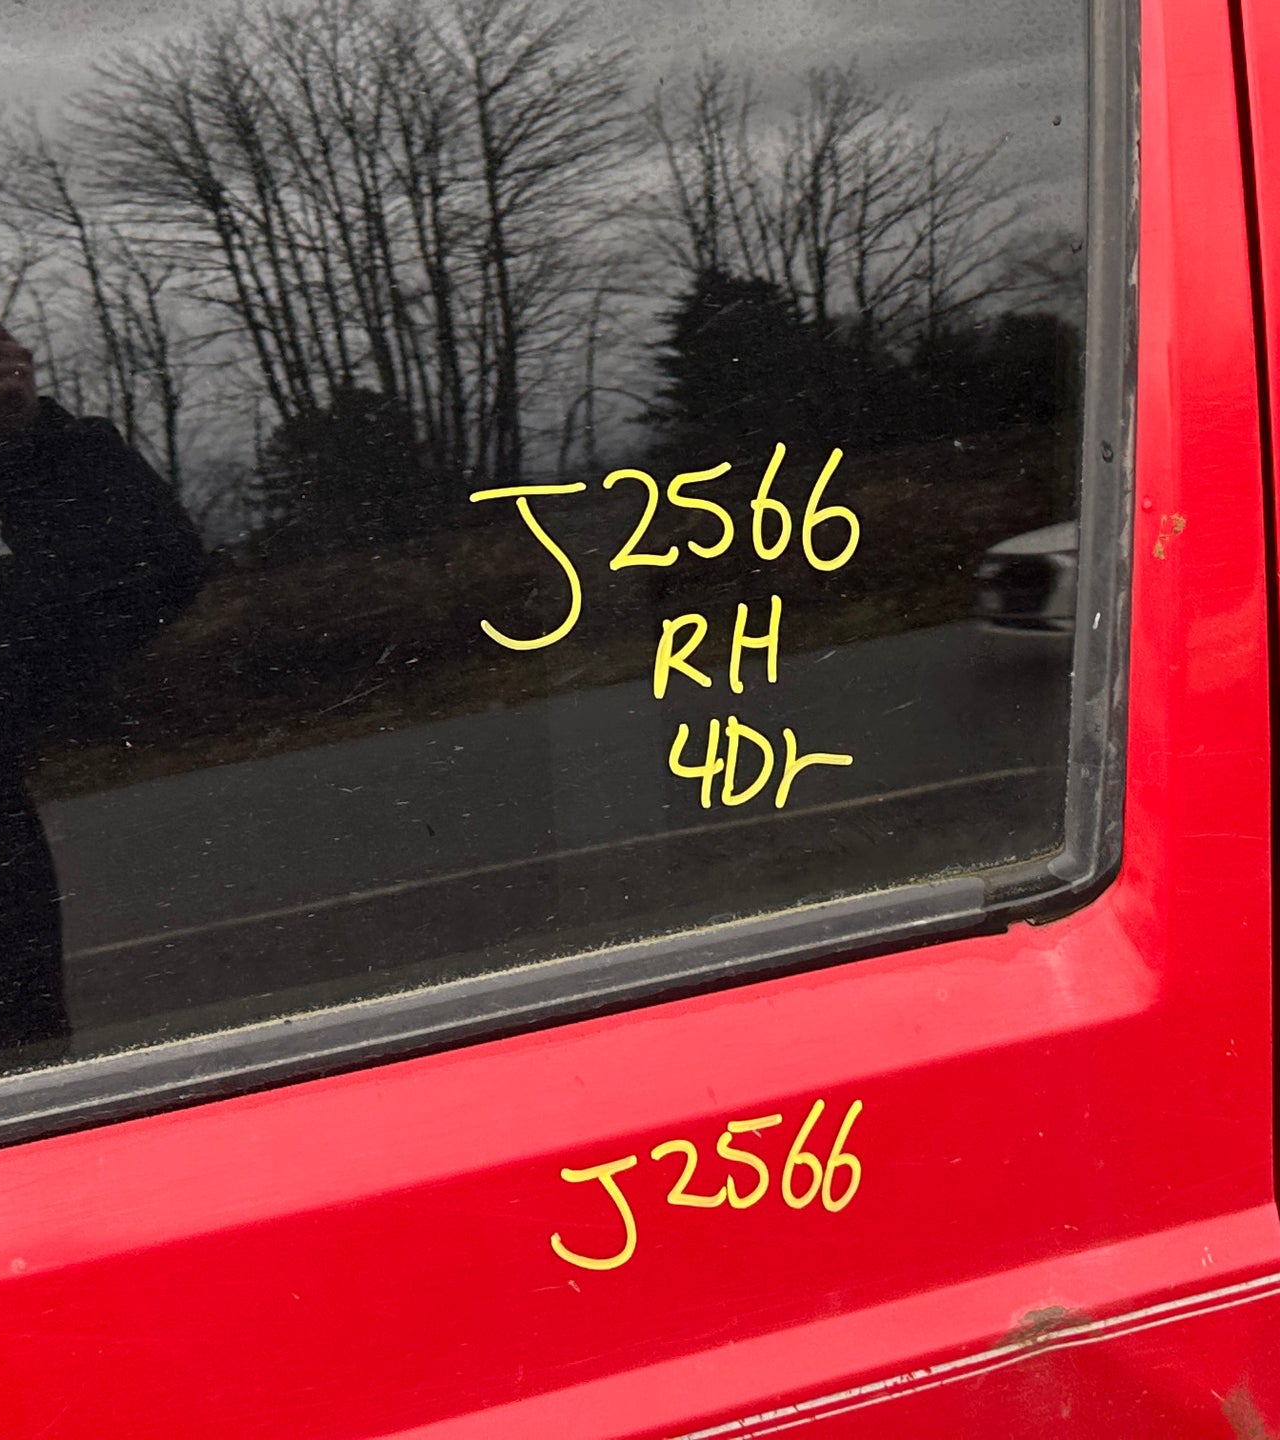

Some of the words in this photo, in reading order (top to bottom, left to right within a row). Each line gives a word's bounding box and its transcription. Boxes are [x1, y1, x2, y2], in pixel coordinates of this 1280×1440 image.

[469, 441, 861, 651] J2566
[653, 594, 783, 700] RH
[550, 1098, 864, 1271] J2566
